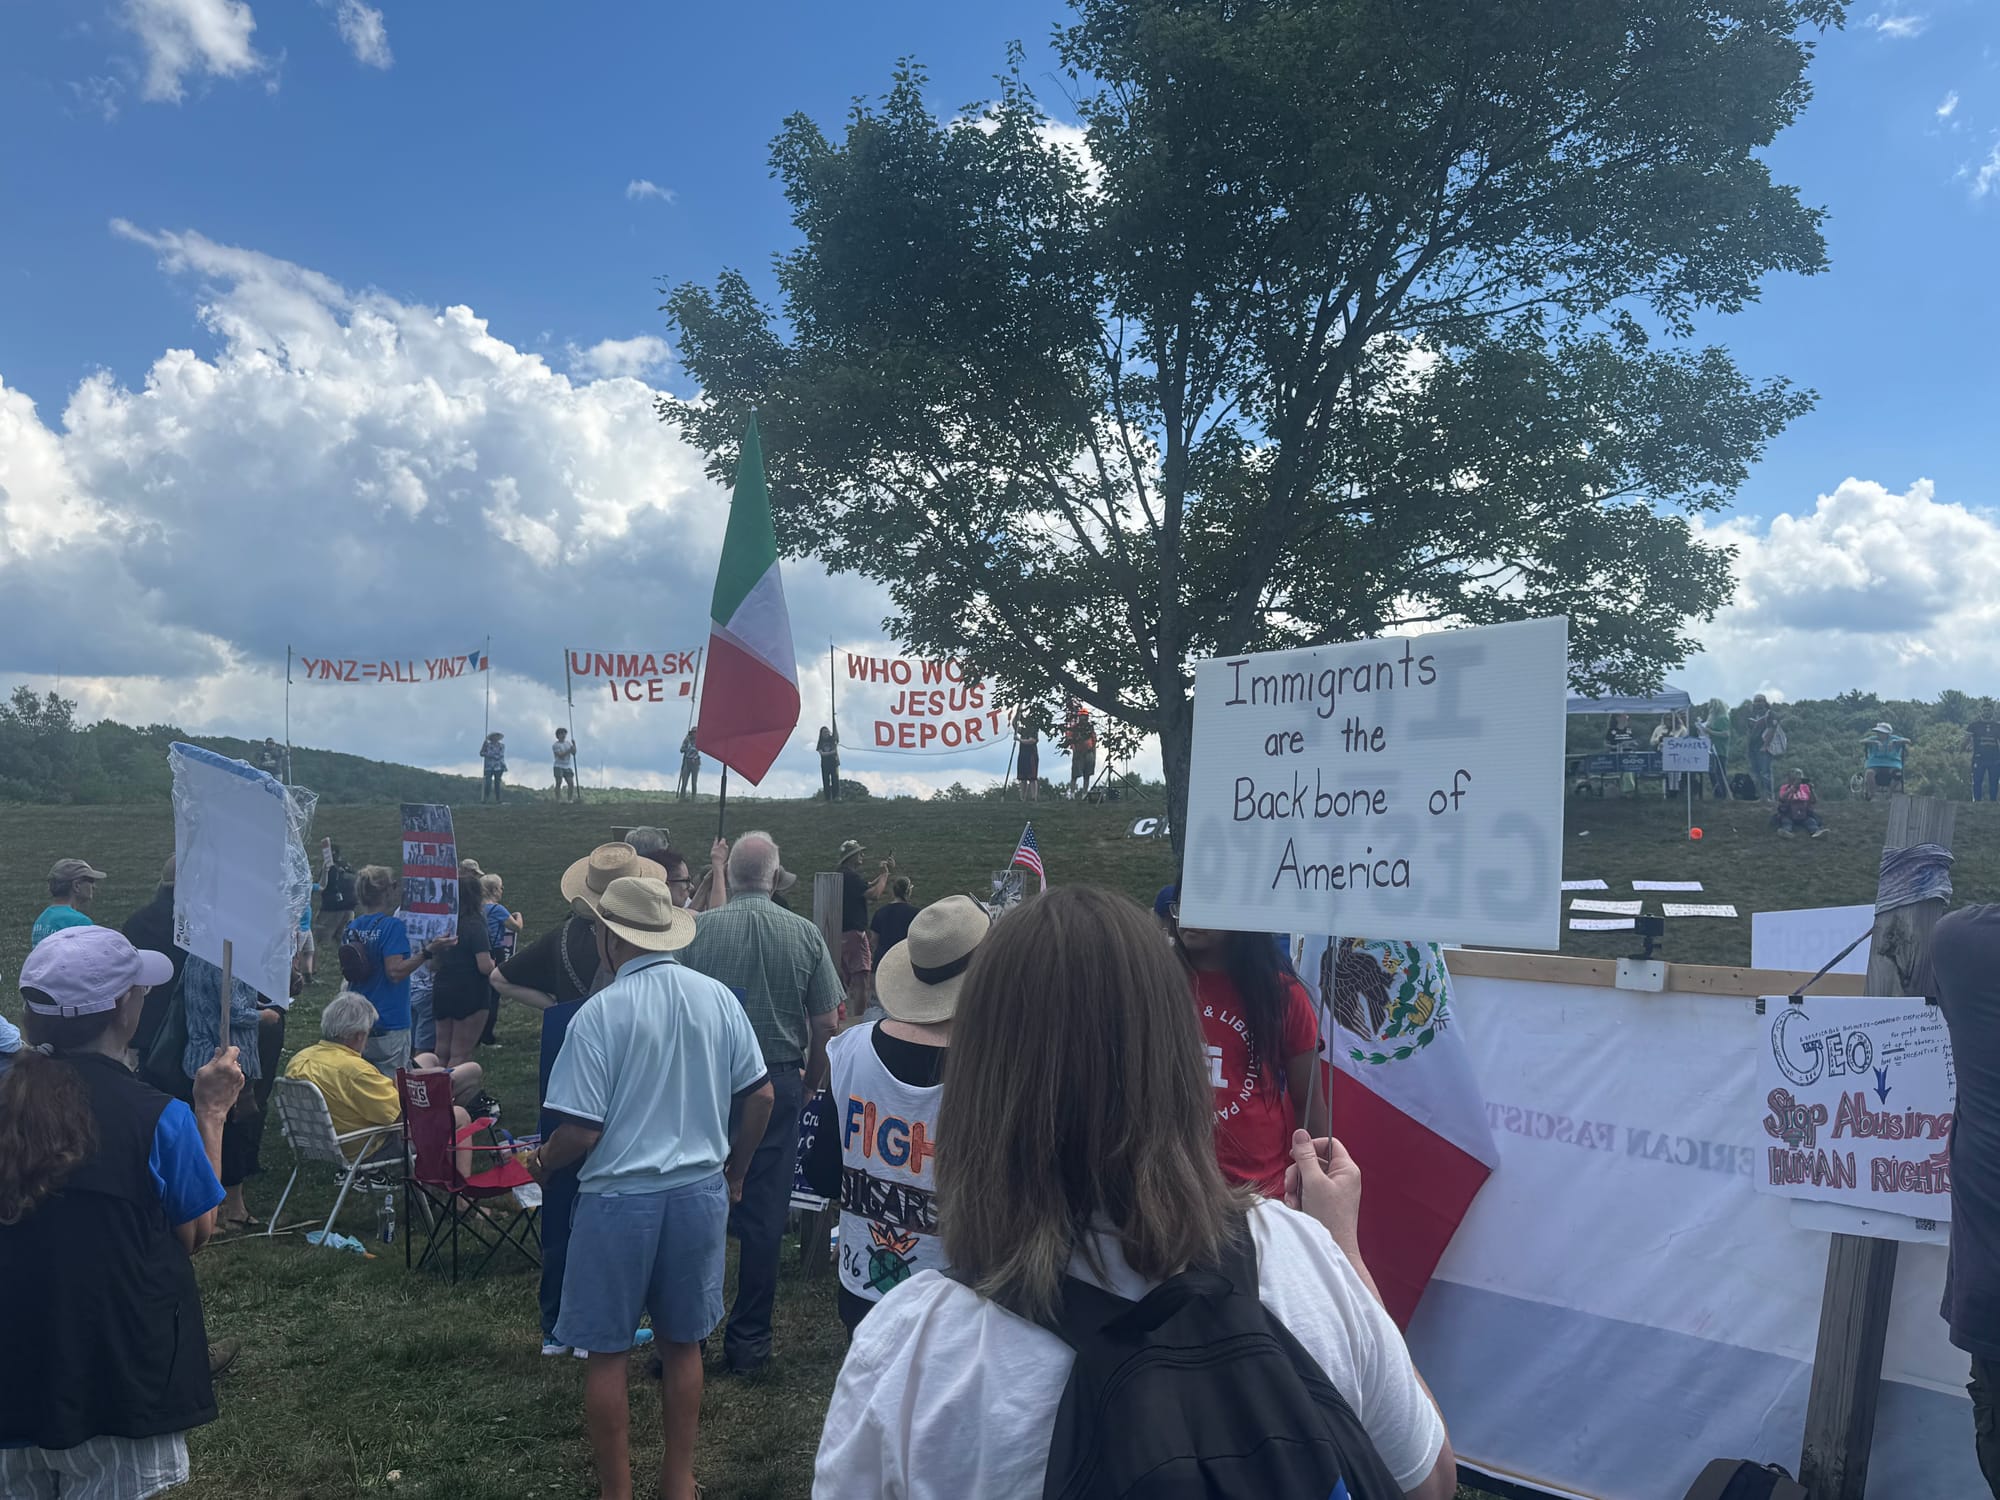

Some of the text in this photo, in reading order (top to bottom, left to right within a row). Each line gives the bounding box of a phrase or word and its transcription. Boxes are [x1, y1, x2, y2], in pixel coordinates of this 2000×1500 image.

[302, 656, 421, 683] YINZ=ALL
[571, 651, 695, 677] UNMASK
[847, 653, 911, 685] WHO
[1225, 640, 1438, 719] Immigrants
[609, 679, 663, 702] ICE
[890, 682, 986, 716] JESUS
[1264, 716, 1386, 756] are the
[1233, 767, 1472, 821] Backbone of
[1272, 837, 1411, 891] America
[1771, 1008, 1873, 1085] GEO
[845, 1095, 936, 1174] FIGH
[1763, 1087, 1828, 1149] Stop
[1768, 1146, 1856, 1190] HUMAN
[844, 1244, 861, 1277] 86
